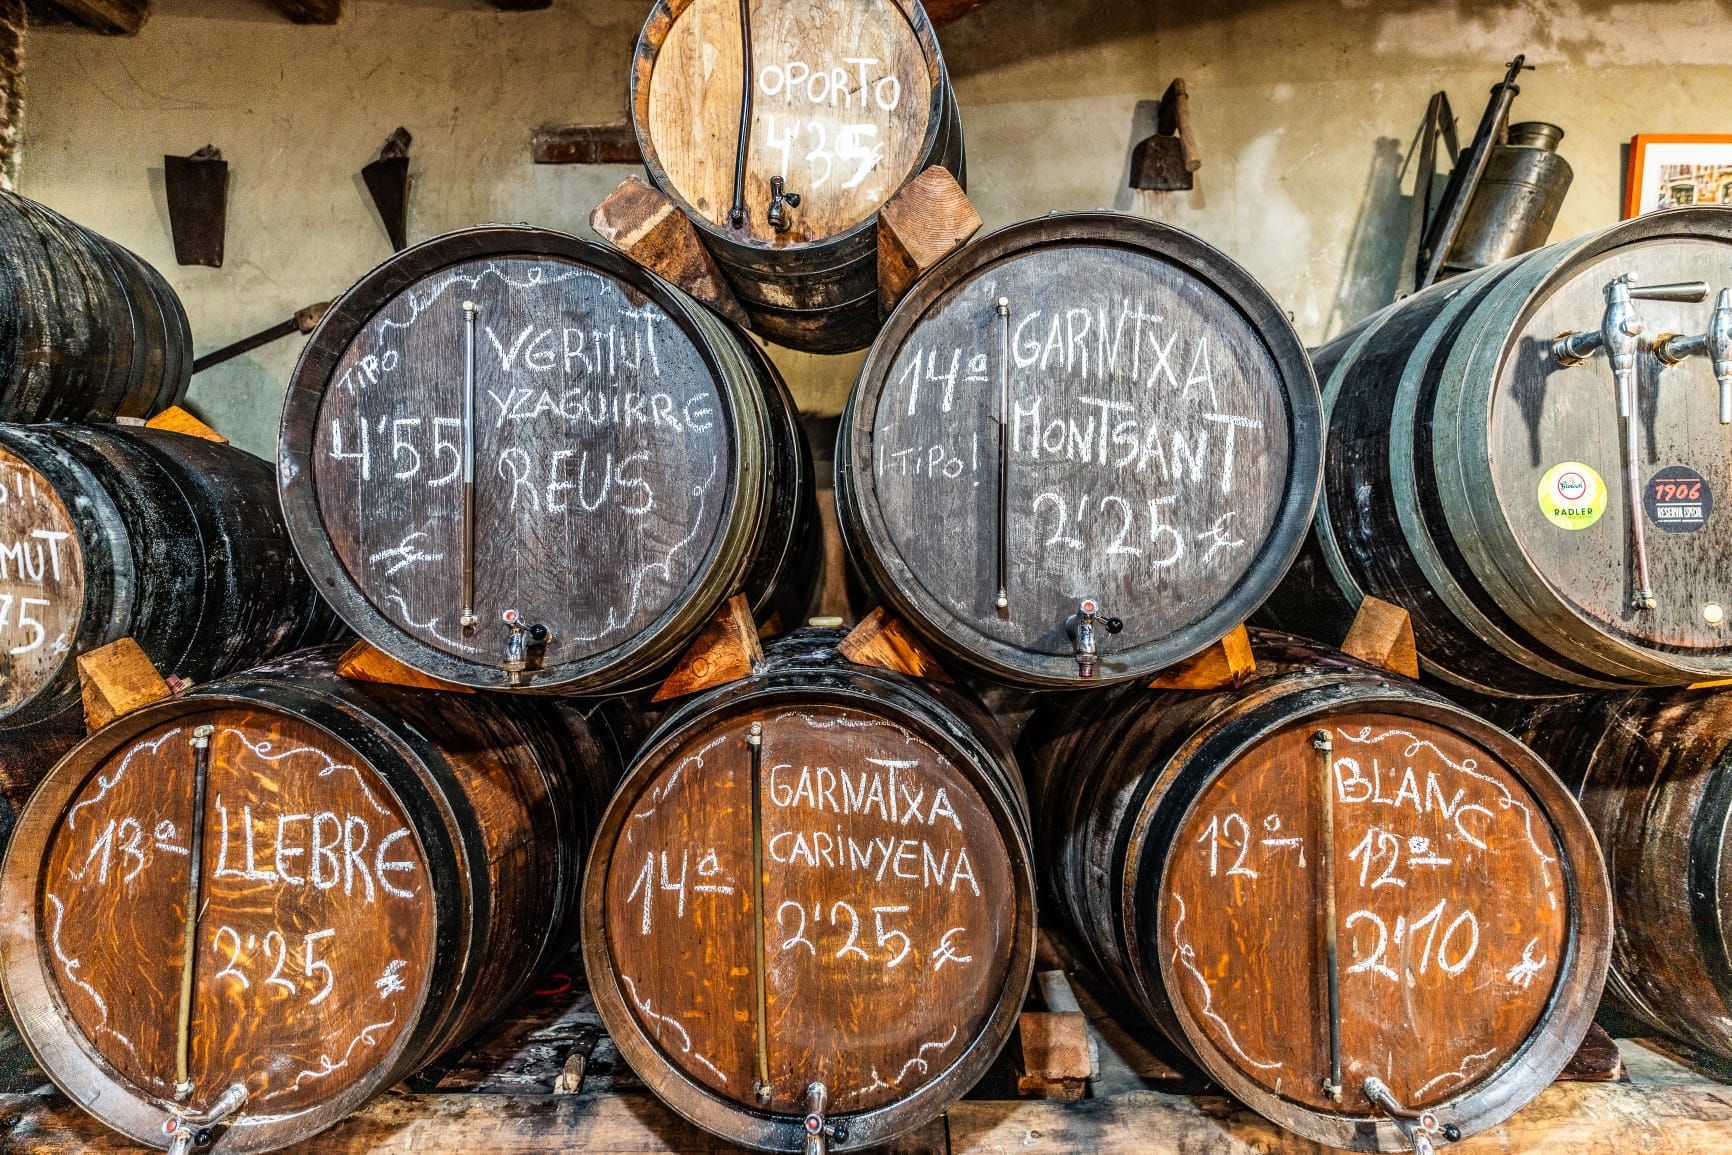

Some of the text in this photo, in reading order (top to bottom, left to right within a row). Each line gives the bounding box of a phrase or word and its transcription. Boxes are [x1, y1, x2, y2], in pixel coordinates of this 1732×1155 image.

[759, 57, 901, 111] OPORTO
[485, 309, 669, 377] VERMUT
[329, 414, 461, 488] 4'55
[498, 447, 656, 516] REUS
[1554, 507, 1594, 517] RADLER
[1655, 482, 1702, 502] 1906
[1032, 491, 1186, 569] 2'25
[769, 757, 963, 832] GARNATXA
[1334, 757, 1494, 850] BLANC
[214, 794, 418, 904] LLEBRE
[213, 925, 337, 1006] 2'25
[776, 900, 912, 968] 2'25
[1345, 898, 1480, 982] 2'10
